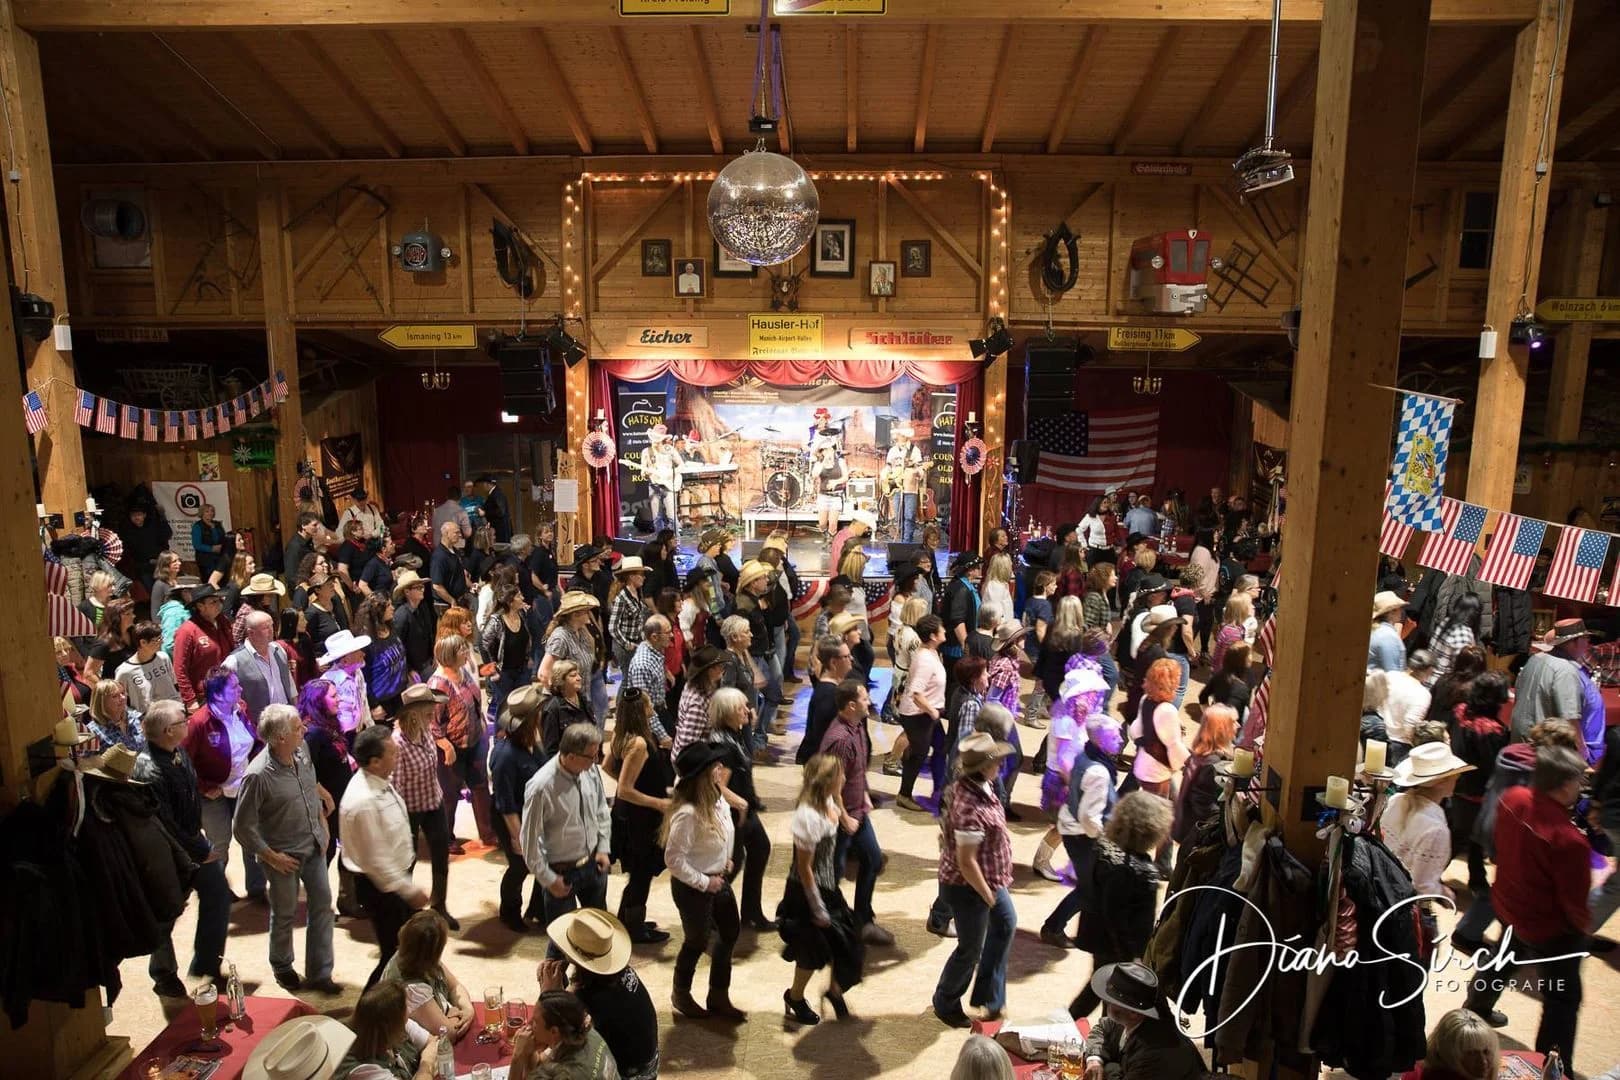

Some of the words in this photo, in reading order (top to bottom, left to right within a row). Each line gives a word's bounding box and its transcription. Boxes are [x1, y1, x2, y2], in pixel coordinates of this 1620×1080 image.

[1552, 301, 1596, 312] Wolnzach
[752, 318, 820, 329] Hausler-Hof
[406, 332, 441, 341] Ismaning
[443, 332, 451, 340] 13
[640, 329, 693, 344] Eicher
[1117, 327, 1151, 341] Freising
[1155, 327, 1163, 339] 11
[1164, 329, 1175, 339] km
[627, 415, 649, 427] HATS
[624, 452, 641, 460] COU
[933, 452, 955, 461] COUN
[631, 474, 648, 482] ROC
